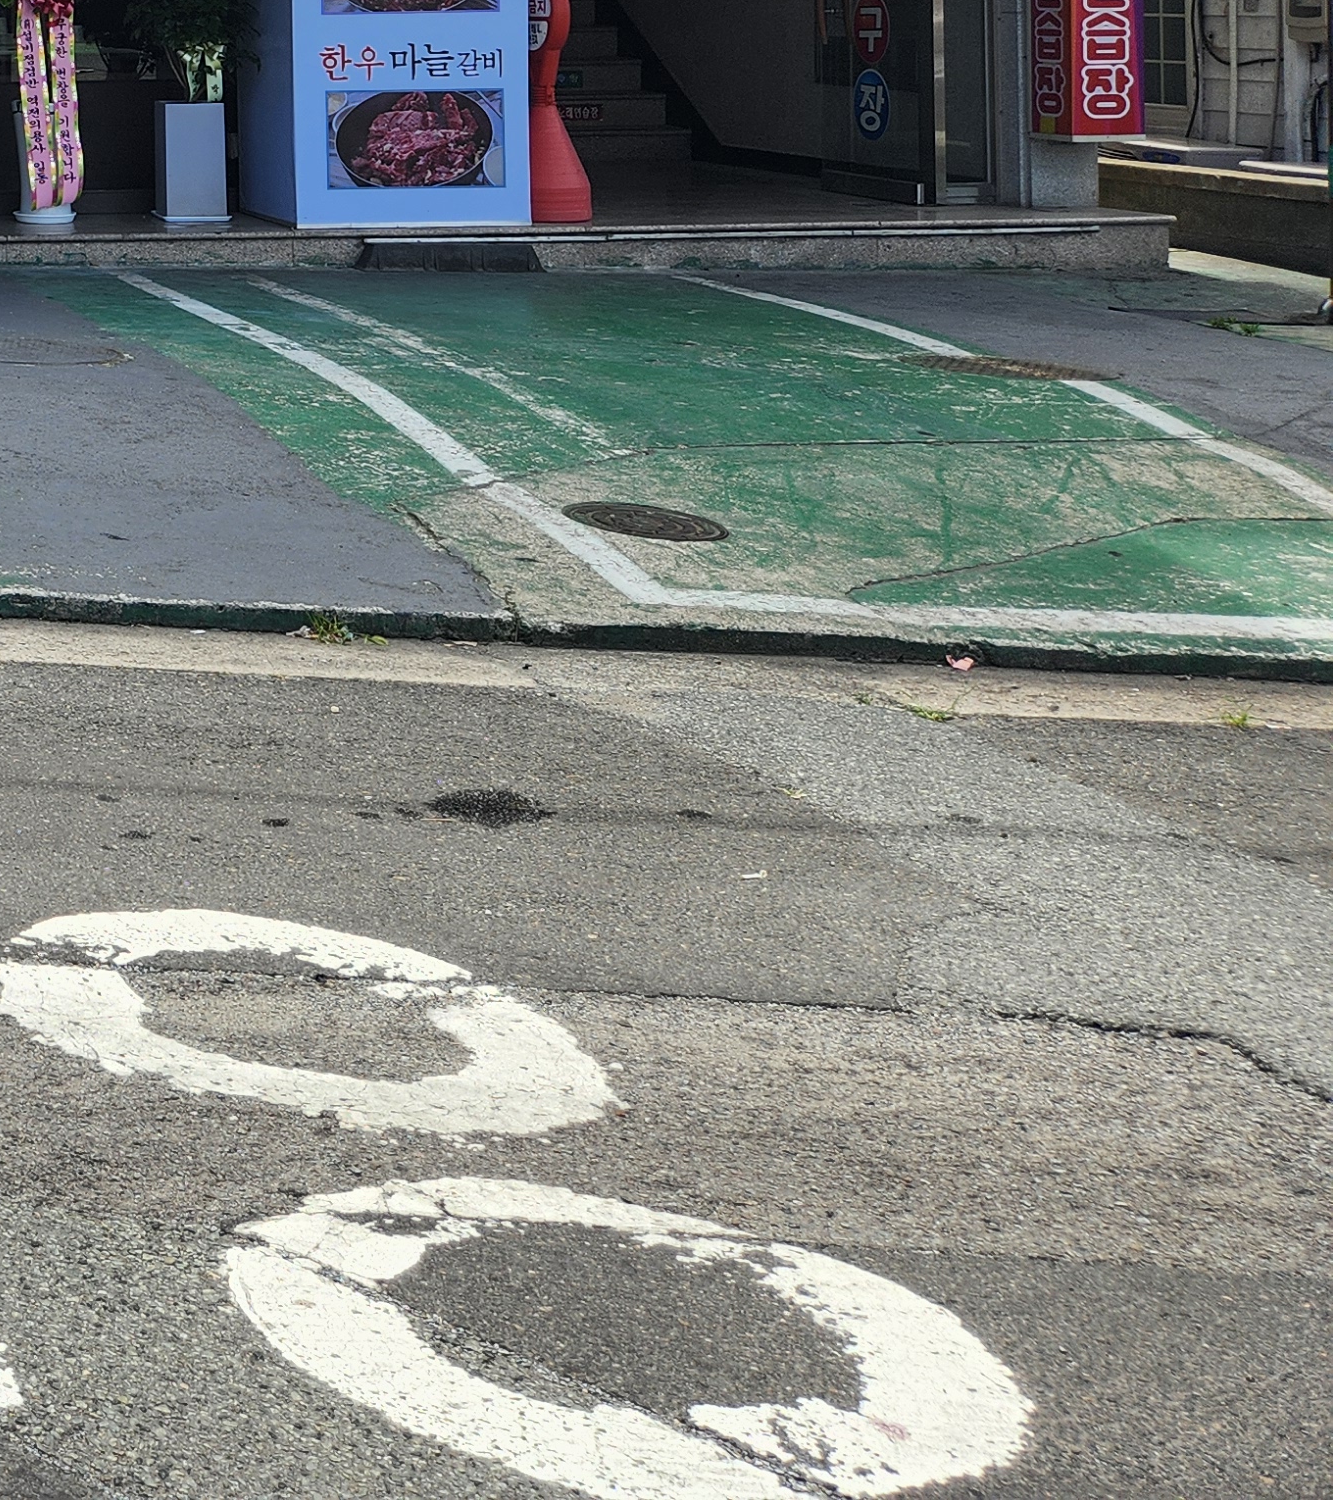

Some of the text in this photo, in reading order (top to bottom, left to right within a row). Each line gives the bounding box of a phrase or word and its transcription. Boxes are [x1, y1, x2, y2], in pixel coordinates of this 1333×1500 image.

[319, 42, 504, 83] 한우 마늘 갈비
